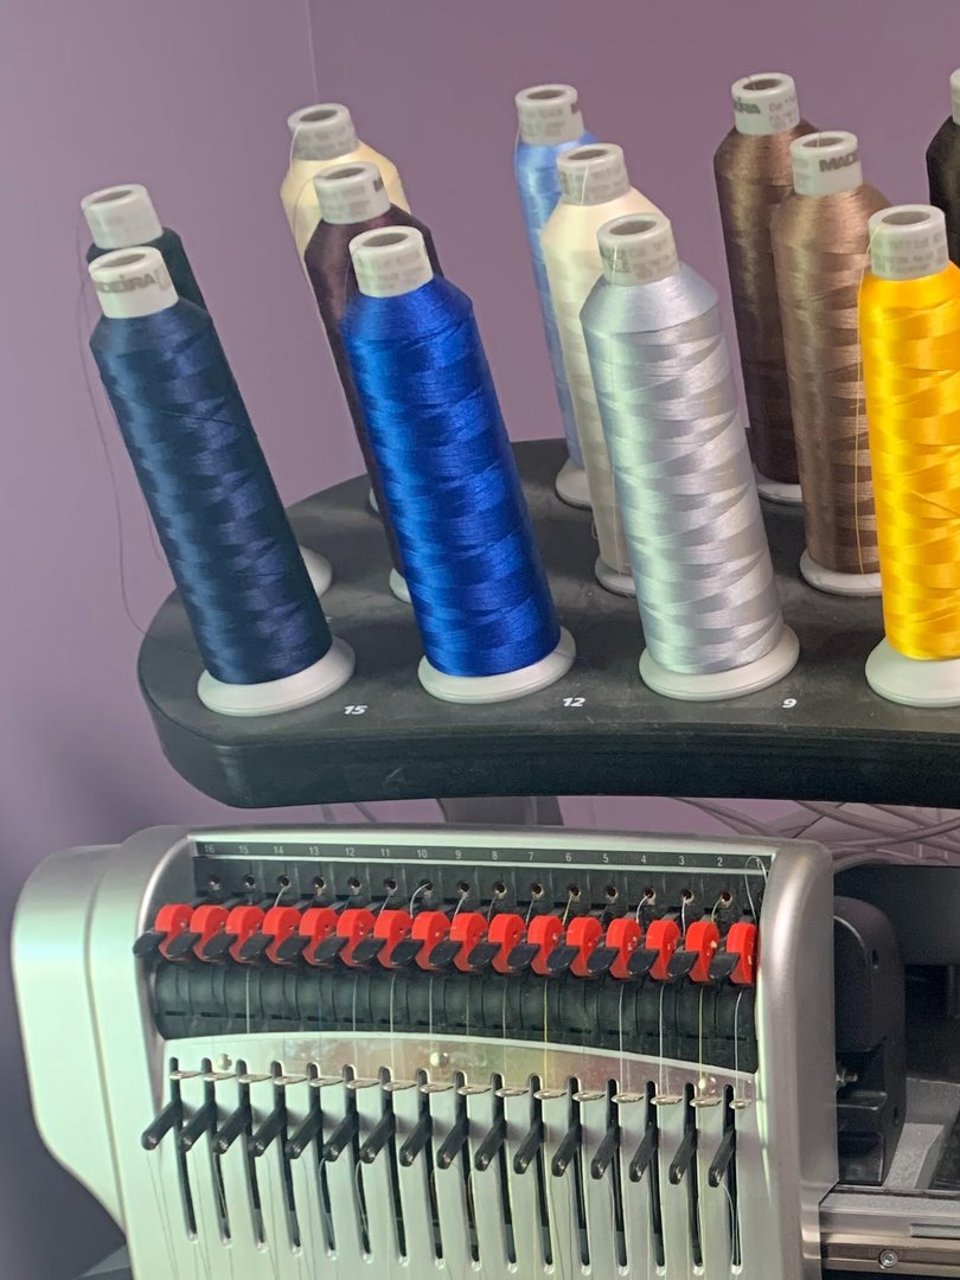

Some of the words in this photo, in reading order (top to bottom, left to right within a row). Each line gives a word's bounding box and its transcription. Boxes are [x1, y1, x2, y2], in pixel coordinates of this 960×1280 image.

[562, 697, 586, 707] 12
[782, 698, 797, 708] 9
[344, 705, 368, 715] 15
[273, 846, 284, 855] 14
[309, 846, 320, 856] 13
[345, 847, 356, 857] 12
[380, 848, 391, 857] 11
[416, 849, 428, 859] 10
[455, 850, 462, 860] 9
[528, 852, 535, 861] 7
[565, 853, 572, 863] 6
[602, 853, 609, 864] 5
[640, 855, 647, 864] 4
[679, 855, 685, 865] 3
[717, 856, 723, 867] 2
